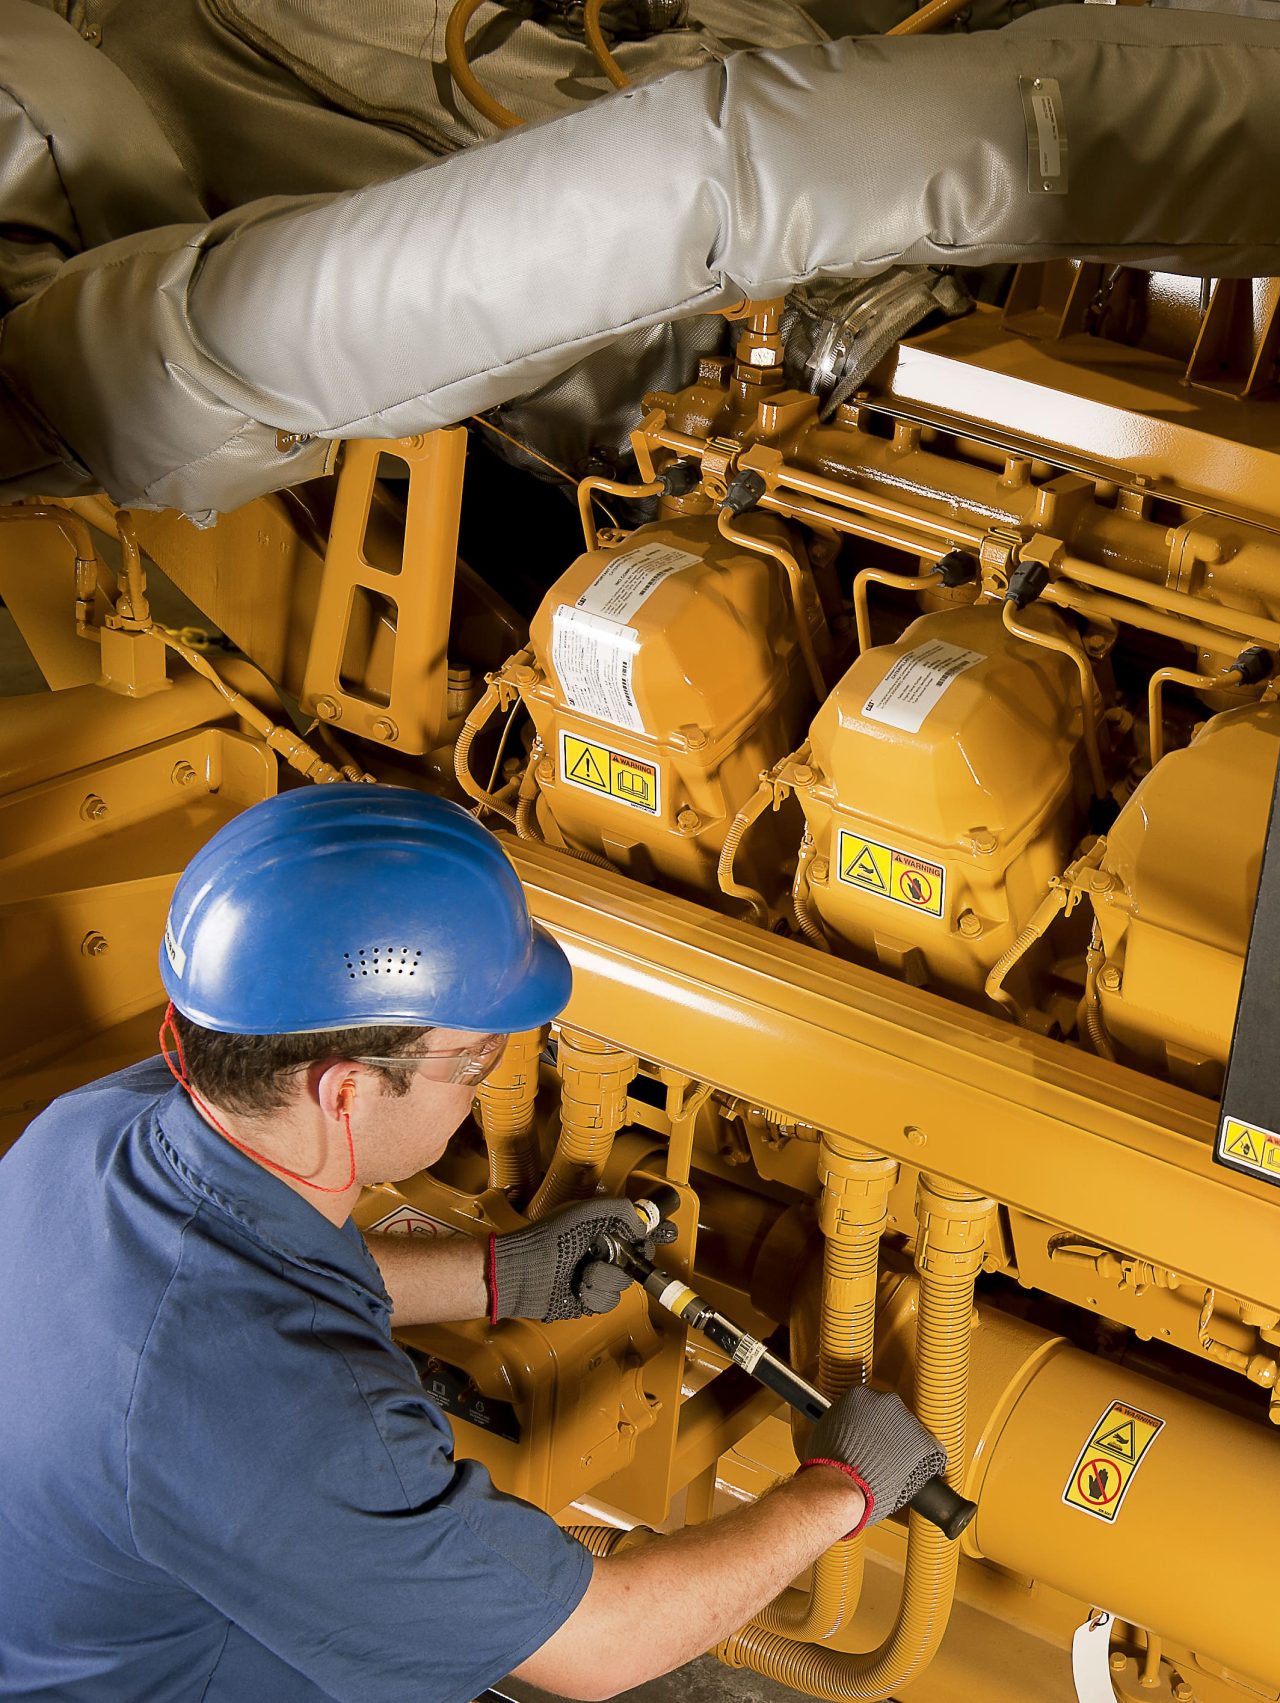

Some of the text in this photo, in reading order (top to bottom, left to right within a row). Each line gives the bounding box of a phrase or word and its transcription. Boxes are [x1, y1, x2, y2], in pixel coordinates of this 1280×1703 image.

[620, 757, 652, 775] WARNING
[903, 857, 941, 878] WARNING
[1123, 1408, 1160, 1428] WARNING
